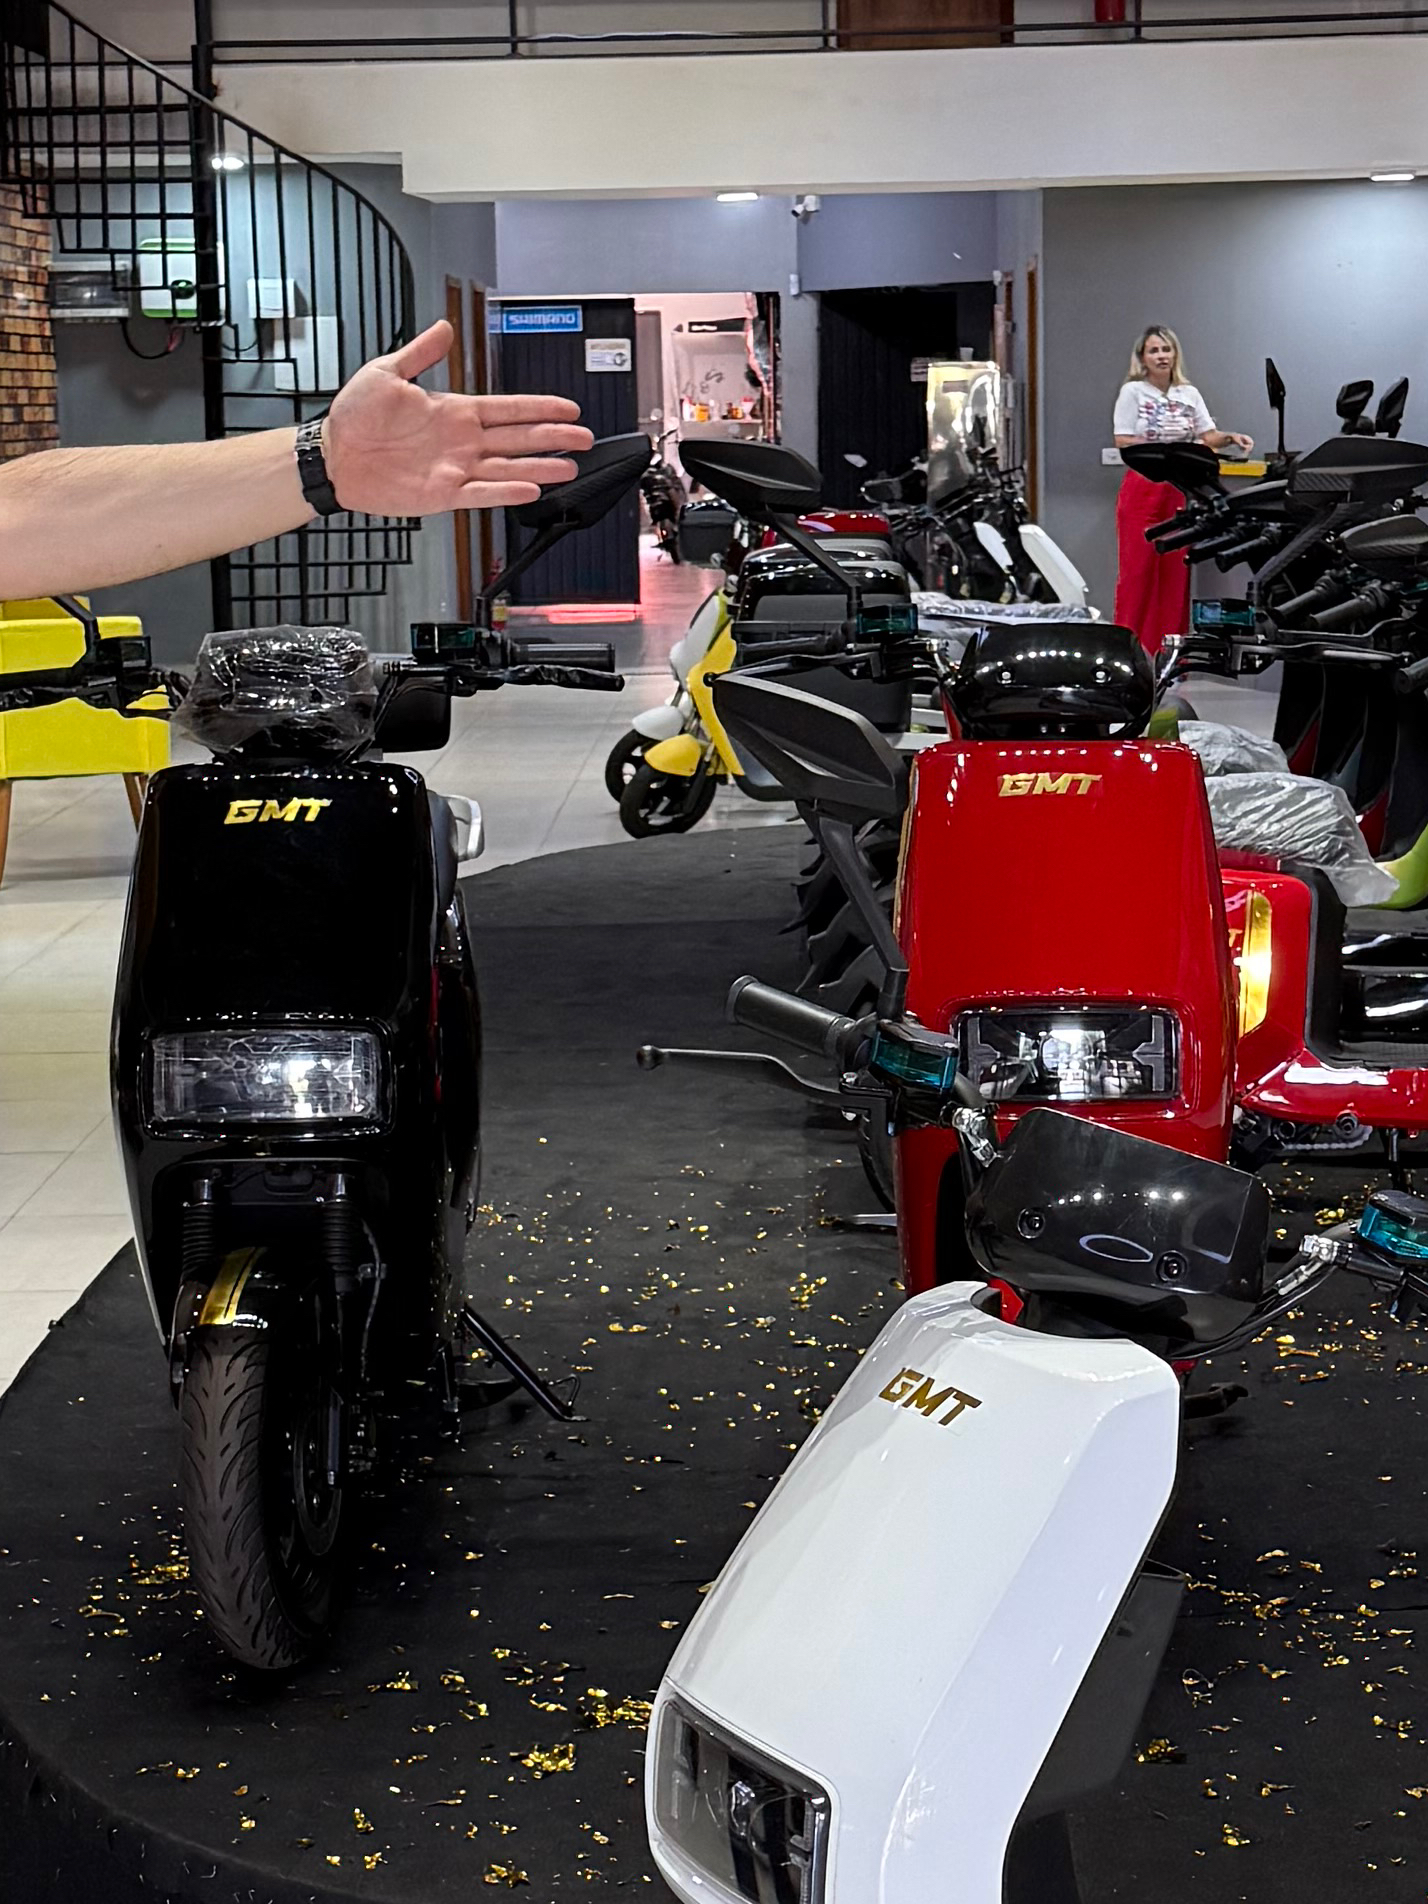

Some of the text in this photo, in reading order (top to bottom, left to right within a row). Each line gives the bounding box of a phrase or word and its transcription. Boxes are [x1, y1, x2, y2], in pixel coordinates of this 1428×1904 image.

[998, 771, 1103, 797] GMT
[224, 796, 332, 825] GMT
[878, 1367, 983, 1427] GMT
